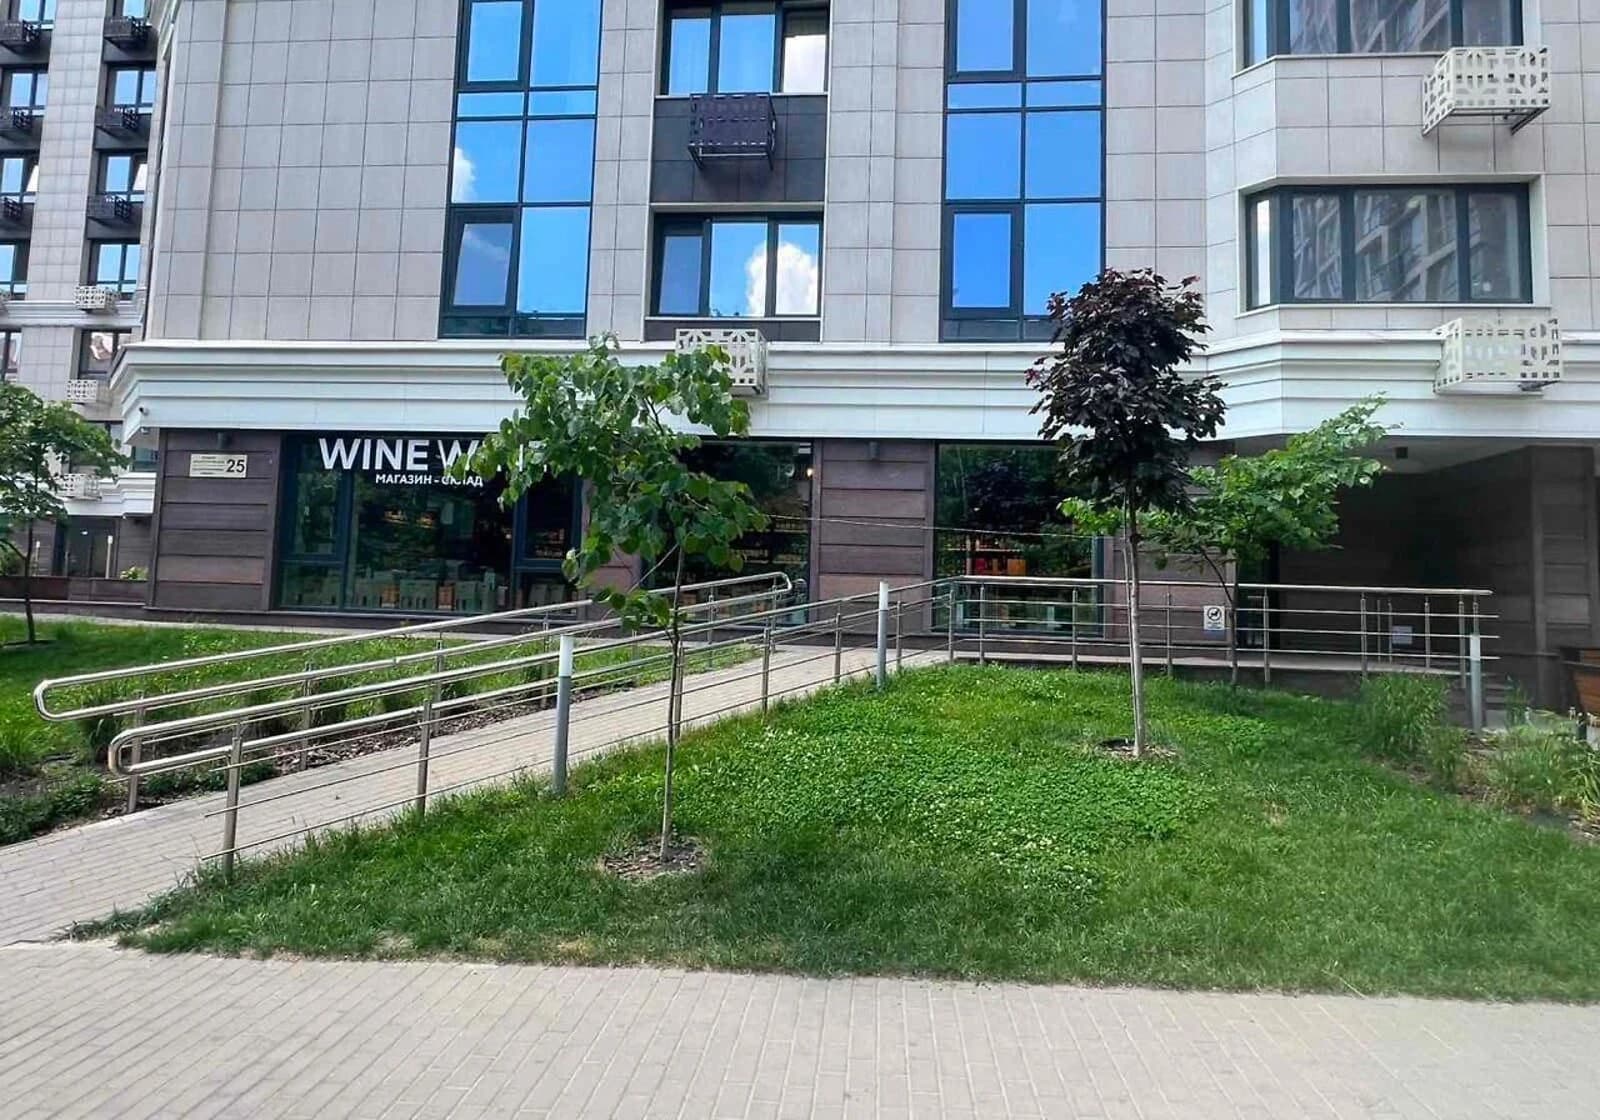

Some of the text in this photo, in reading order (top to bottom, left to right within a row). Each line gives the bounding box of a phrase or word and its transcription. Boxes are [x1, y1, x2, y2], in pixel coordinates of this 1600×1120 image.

[319, 438, 429, 471] WINE
[226, 458, 245, 473] 25
[375, 474, 432, 485] МАГАЗИН
